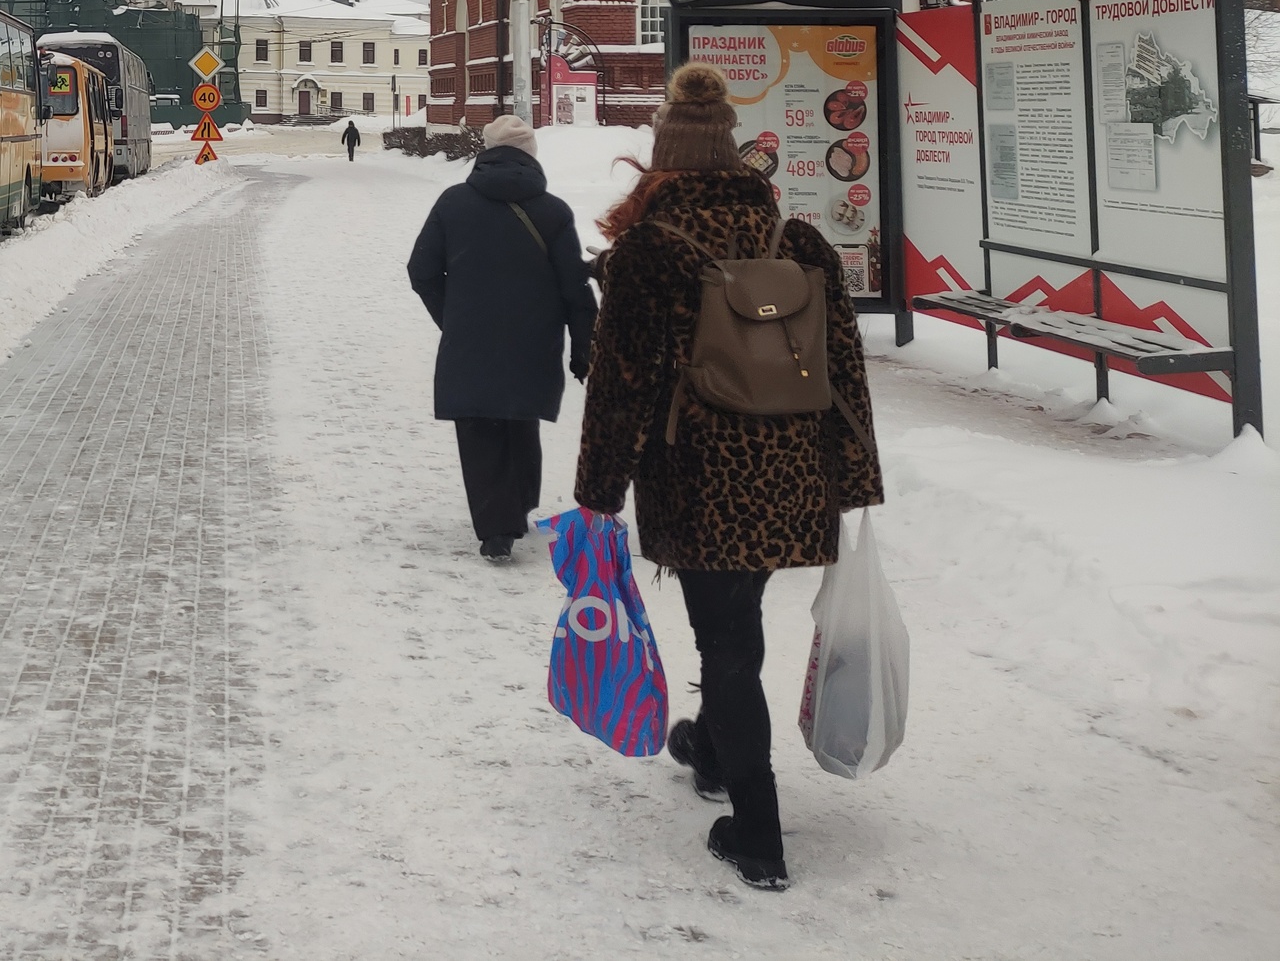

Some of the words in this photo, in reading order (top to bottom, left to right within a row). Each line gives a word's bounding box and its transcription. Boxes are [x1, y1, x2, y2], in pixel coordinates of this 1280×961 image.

[994, 11, 1040, 30] ВЛАДИМИР
[1046, 7, 1078, 25] ГОРОД
[692, 36, 766, 50] ПРАЗДНИК
[693, 54, 766, 65] НАЧИНАЕТСЯ
[198, 92, 216, 103] 40
[785, 109, 805, 127] 59
[805, 110, 814, 118] 99
[915, 111, 950, 125] ВЛАДИМИР
[915, 130, 937, 144] ГОРОД
[938, 129, 974, 146] ТРУДОВОЙ
[916, 149, 950, 163] ДОБЛЕСТИ
[786, 160, 816, 177] 489
